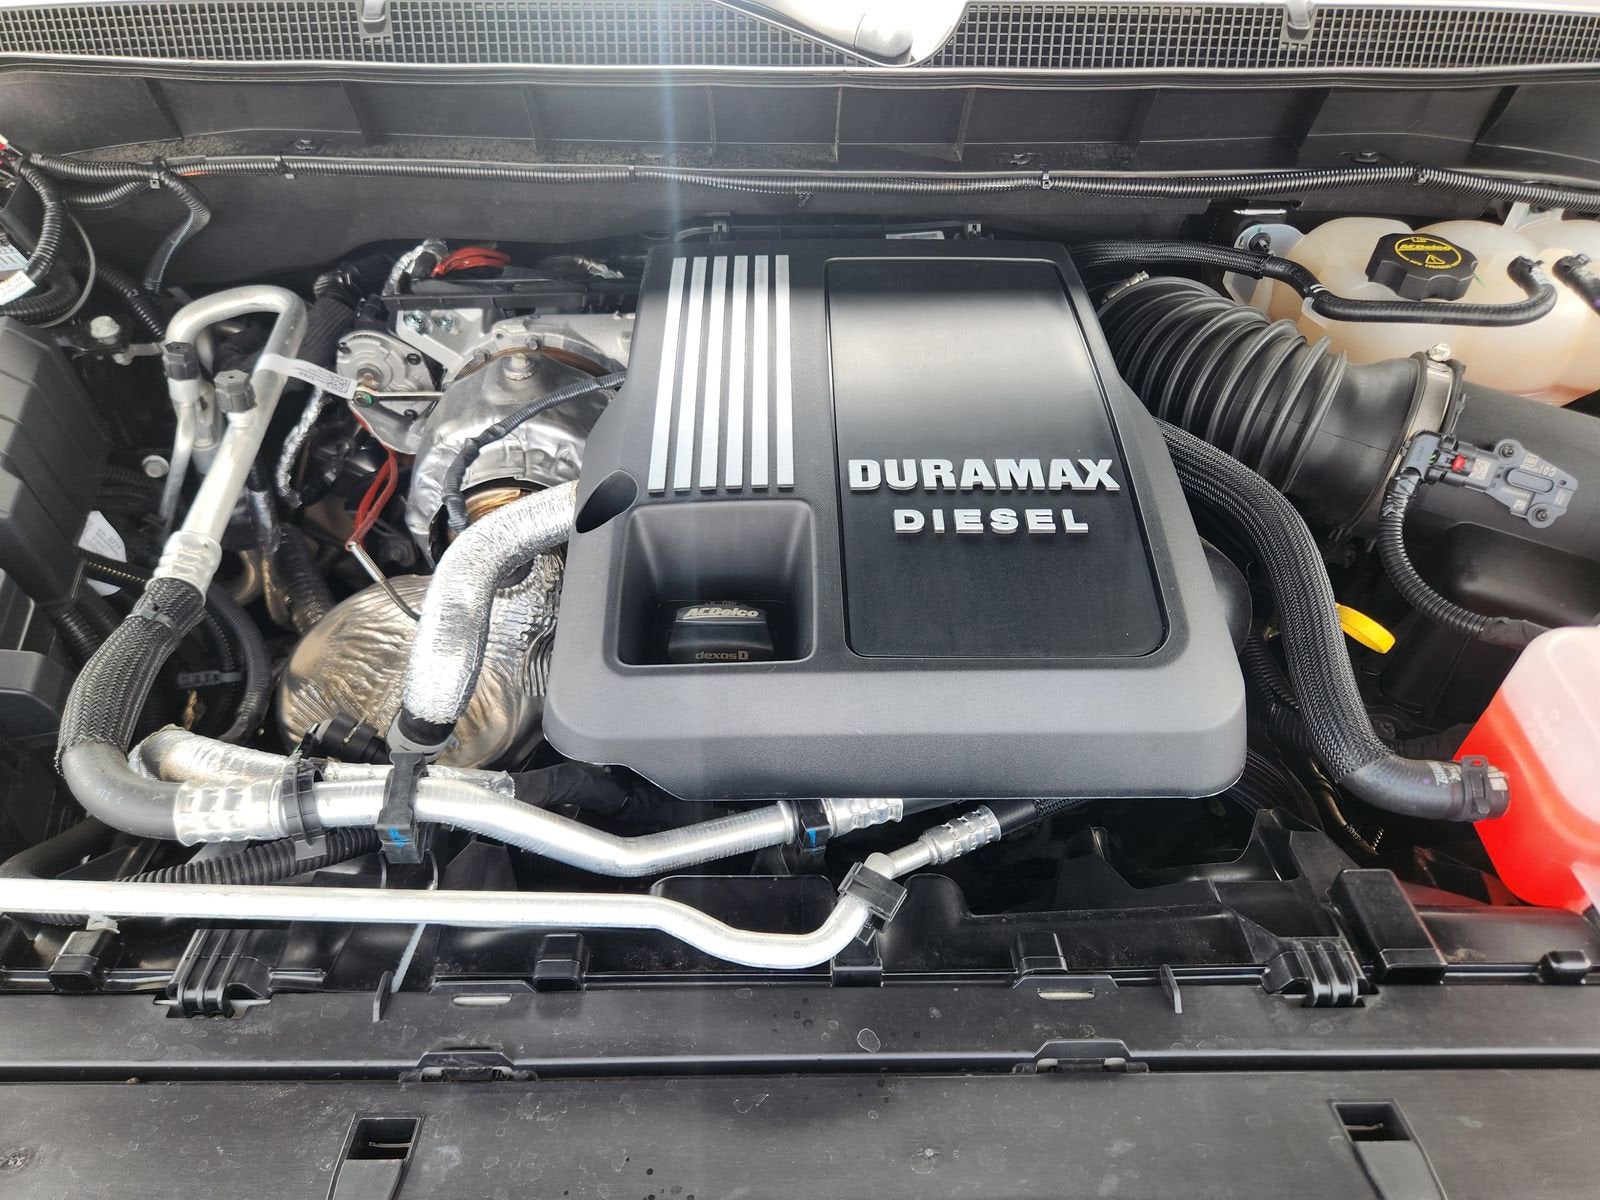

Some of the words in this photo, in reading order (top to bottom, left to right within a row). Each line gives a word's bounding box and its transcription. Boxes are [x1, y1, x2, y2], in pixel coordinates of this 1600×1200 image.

[848, 458, 1121, 491] DURAMAX
[893, 507, 1089, 534] DIESEL
[684, 606, 760, 618] ACDelco
